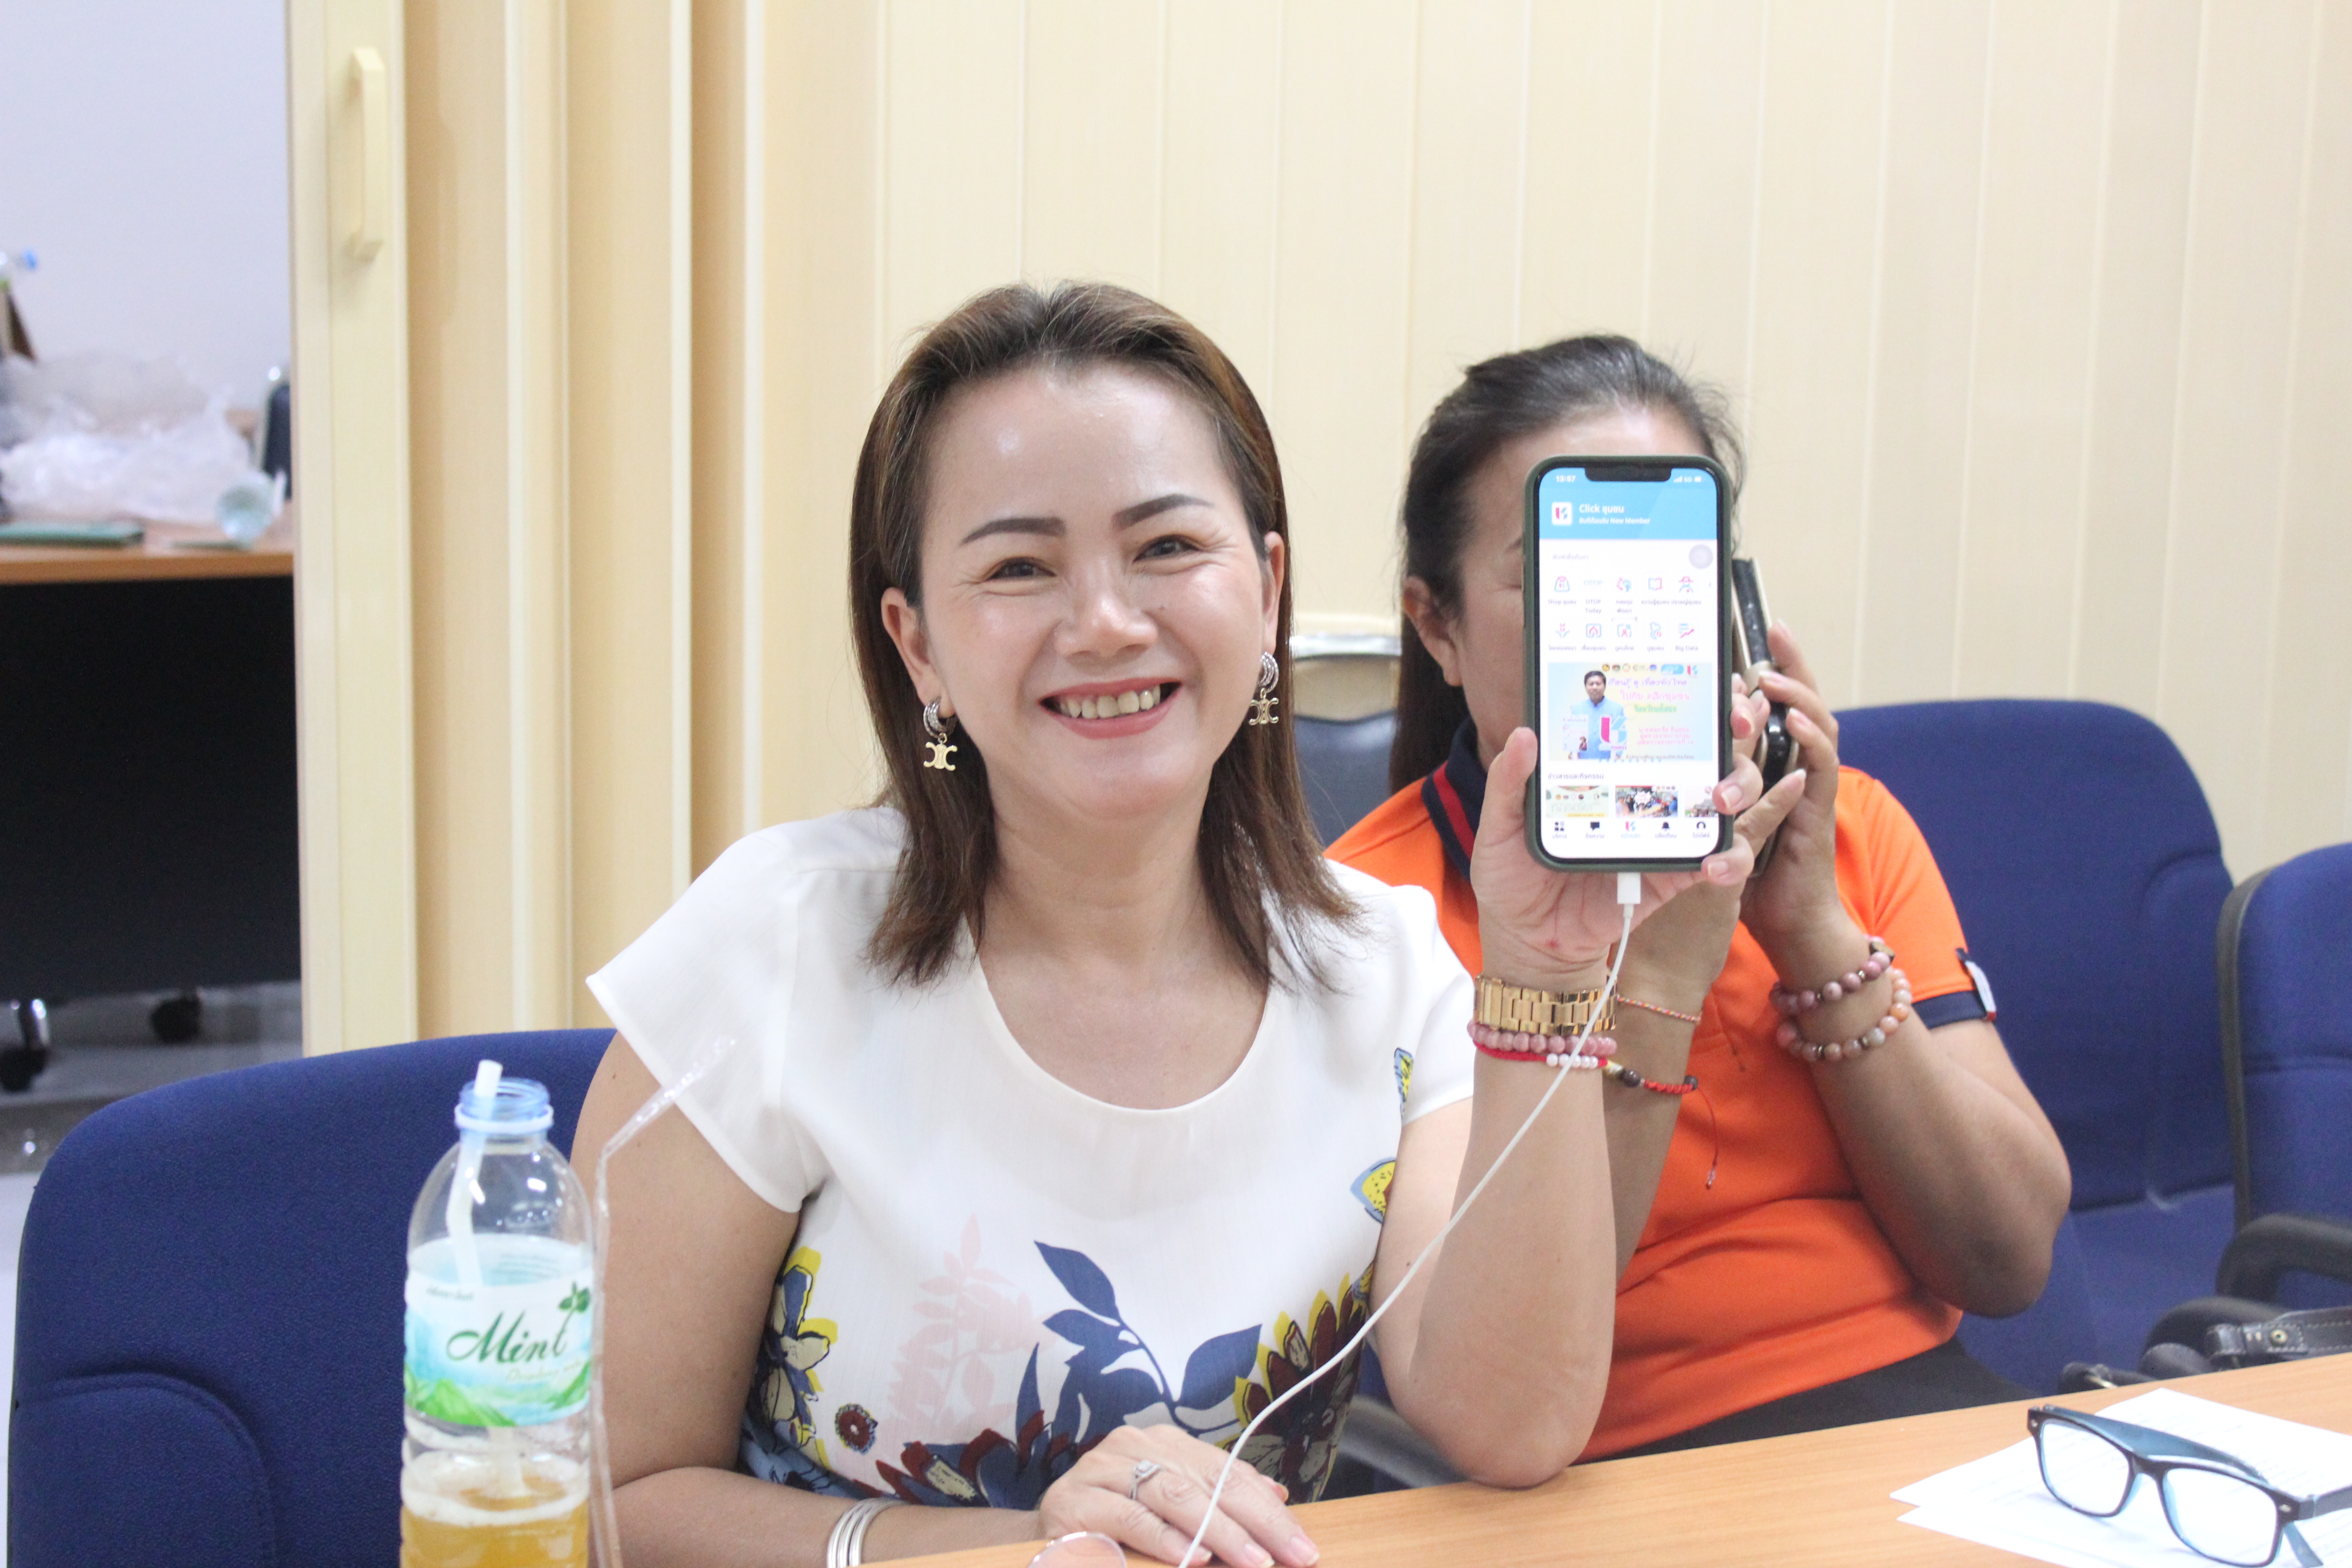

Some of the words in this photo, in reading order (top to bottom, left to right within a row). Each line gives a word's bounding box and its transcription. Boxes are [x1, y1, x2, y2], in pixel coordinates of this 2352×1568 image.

[1579, 504, 1600, 514] Click
[1602, 505, 1624, 515] ชุมชน
[447, 1310, 573, 1365] Mint
